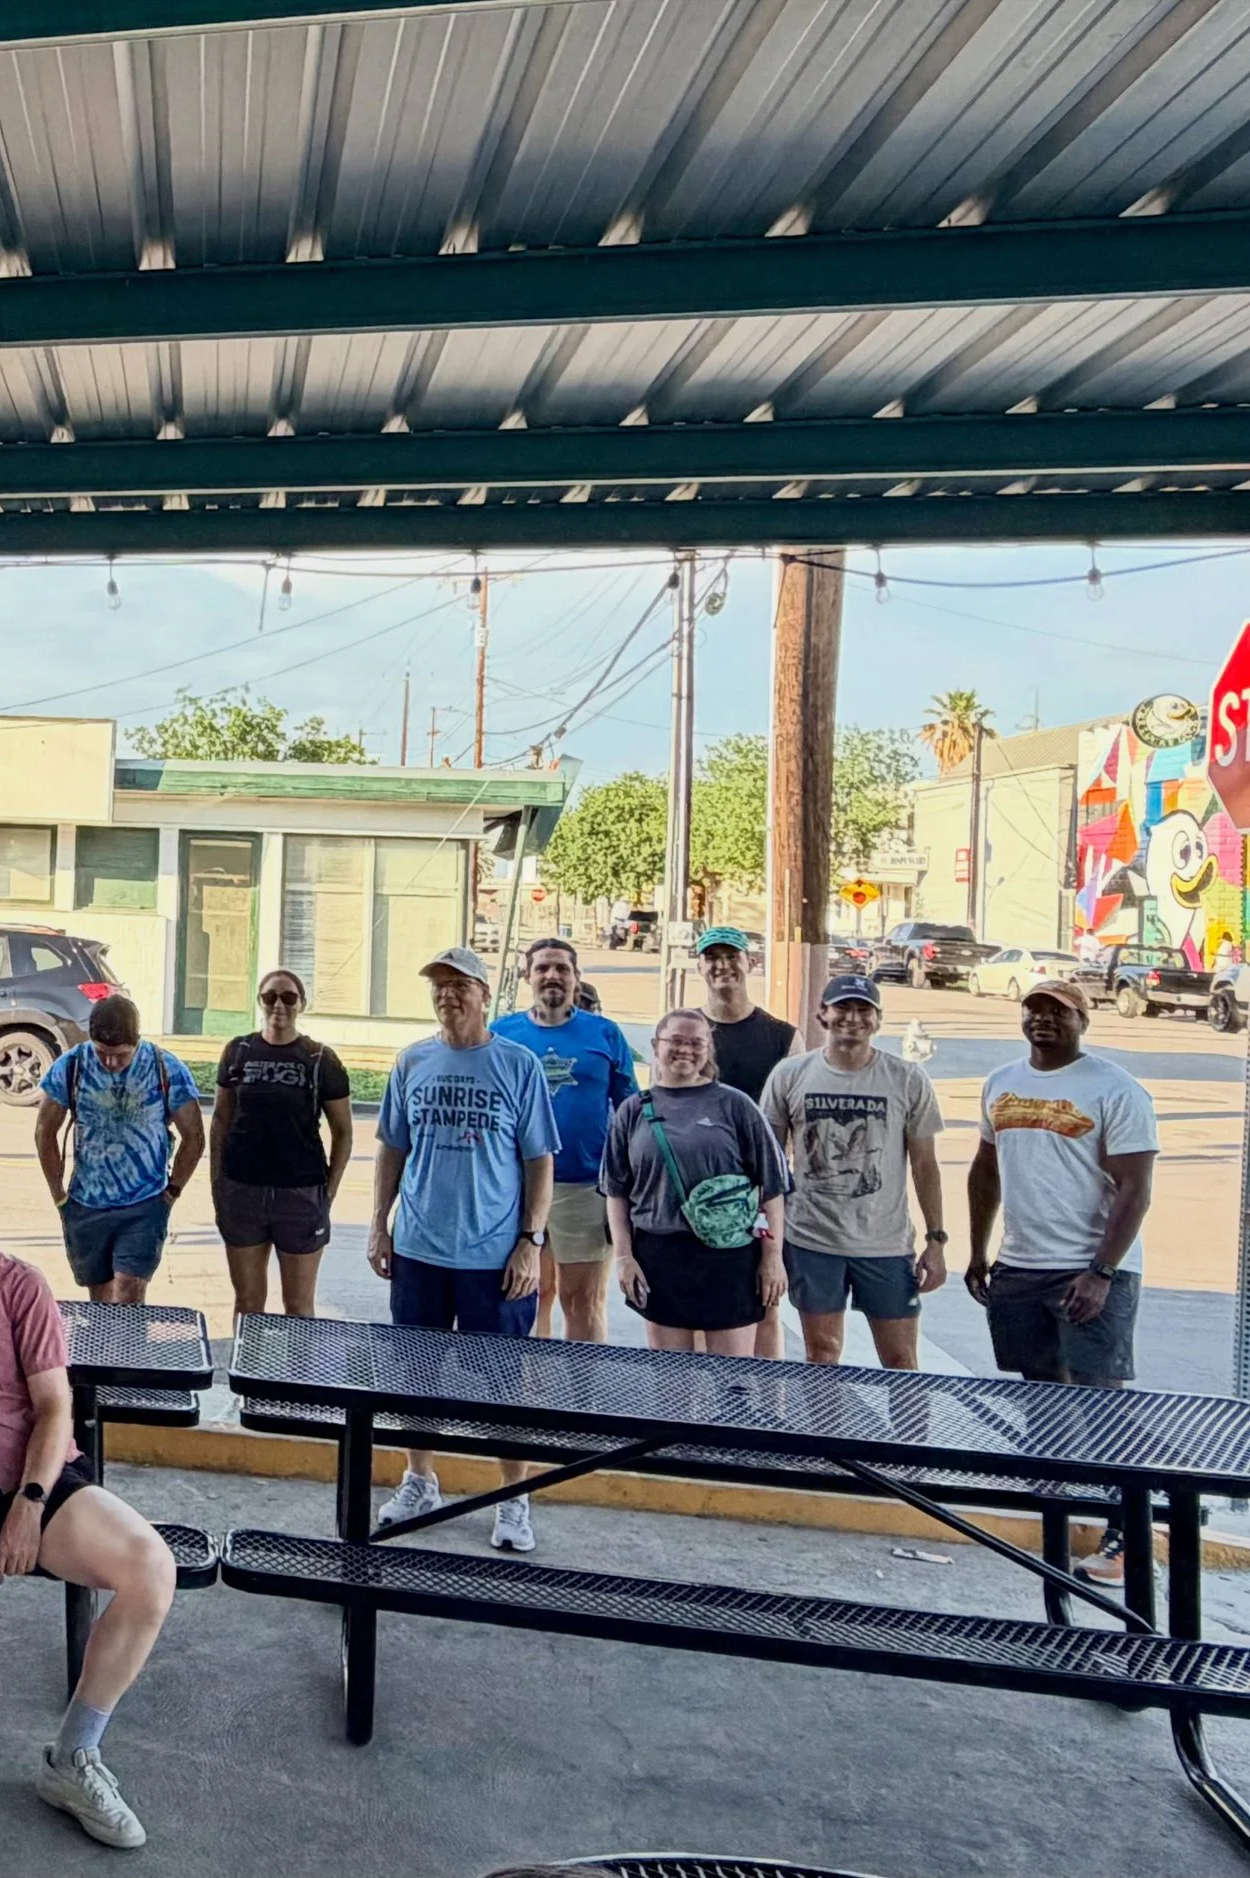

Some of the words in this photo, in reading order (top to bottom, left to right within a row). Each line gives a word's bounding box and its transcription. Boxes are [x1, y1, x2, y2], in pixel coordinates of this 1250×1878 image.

[412, 1086, 501, 1112] SUNRISE
[805, 1096, 887, 1112] SILVERADA
[412, 1108, 501, 1132] STAMPEDE
